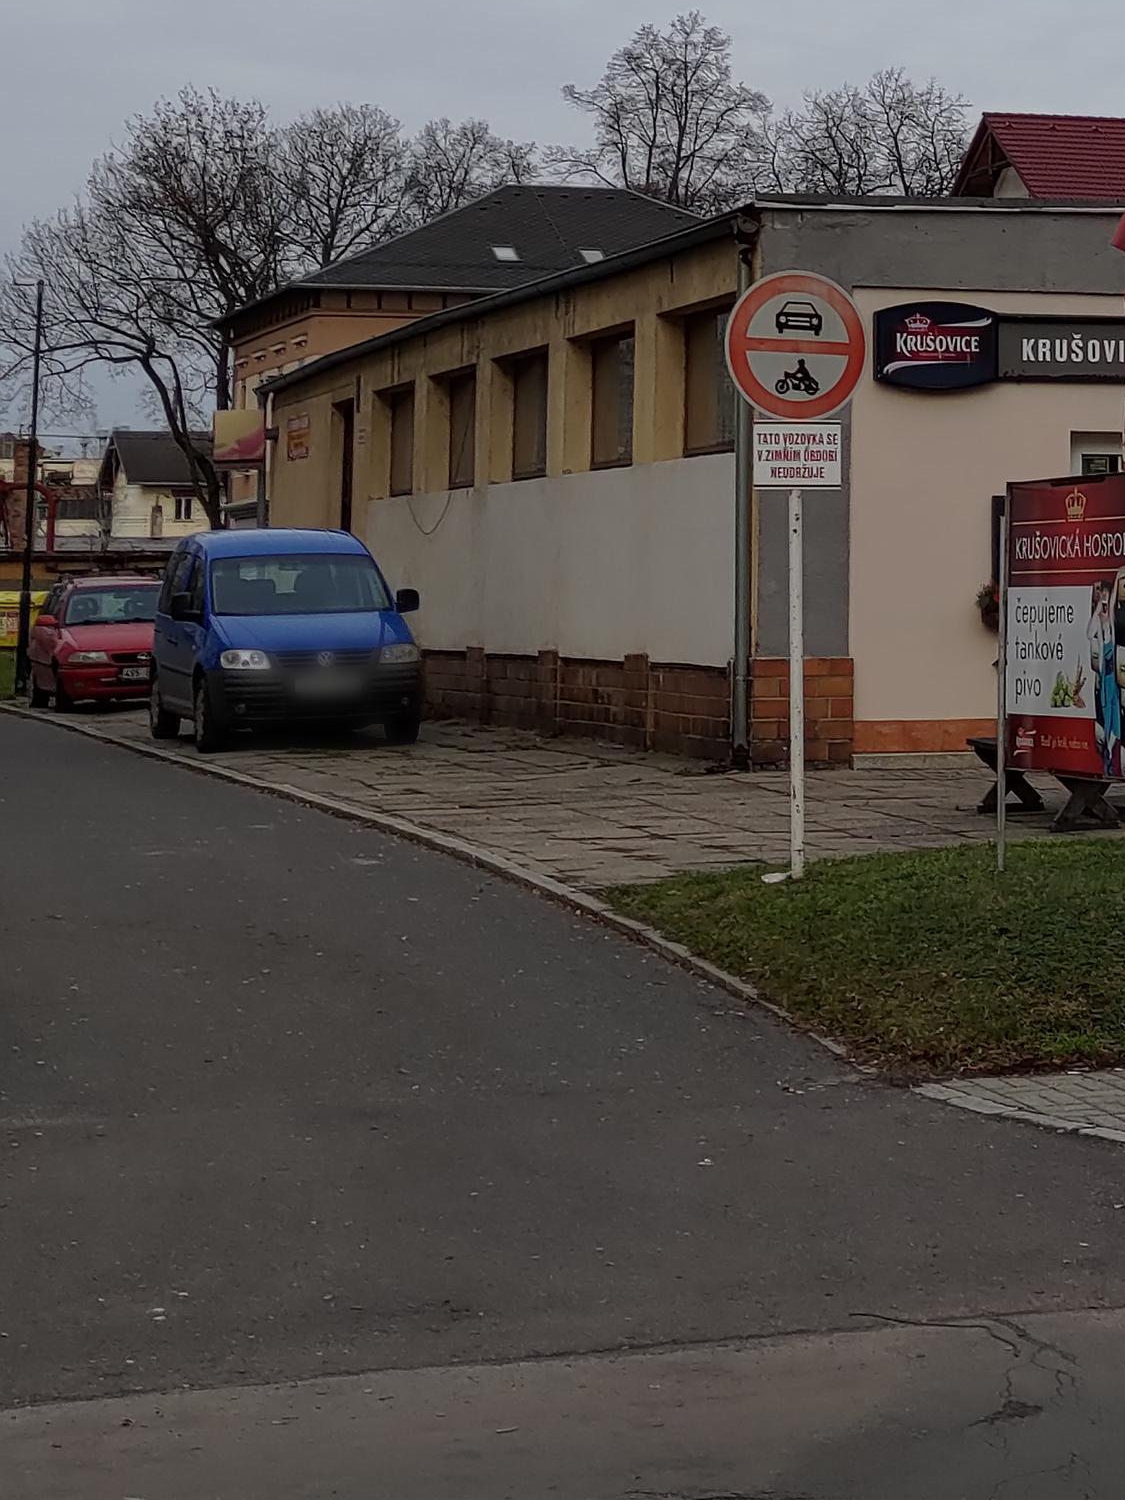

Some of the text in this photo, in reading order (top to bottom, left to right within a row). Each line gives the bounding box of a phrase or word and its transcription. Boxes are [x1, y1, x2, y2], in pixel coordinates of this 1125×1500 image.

[896, 332, 980, 357] KRUŠOVICE
[756, 432, 839, 446] TATO VOZOVKA SE
[757, 447, 838, 462] V ZIMNÍM OBDOBÍ
[770, 463, 825, 479] NEUDRŽUJE
[1015, 528, 1082, 560] KRUŠOVICKÁ
[1015, 597, 1074, 631] čepujeme
[1015, 632, 1064, 661] tankové
[1015, 670, 1042, 704] pivo
